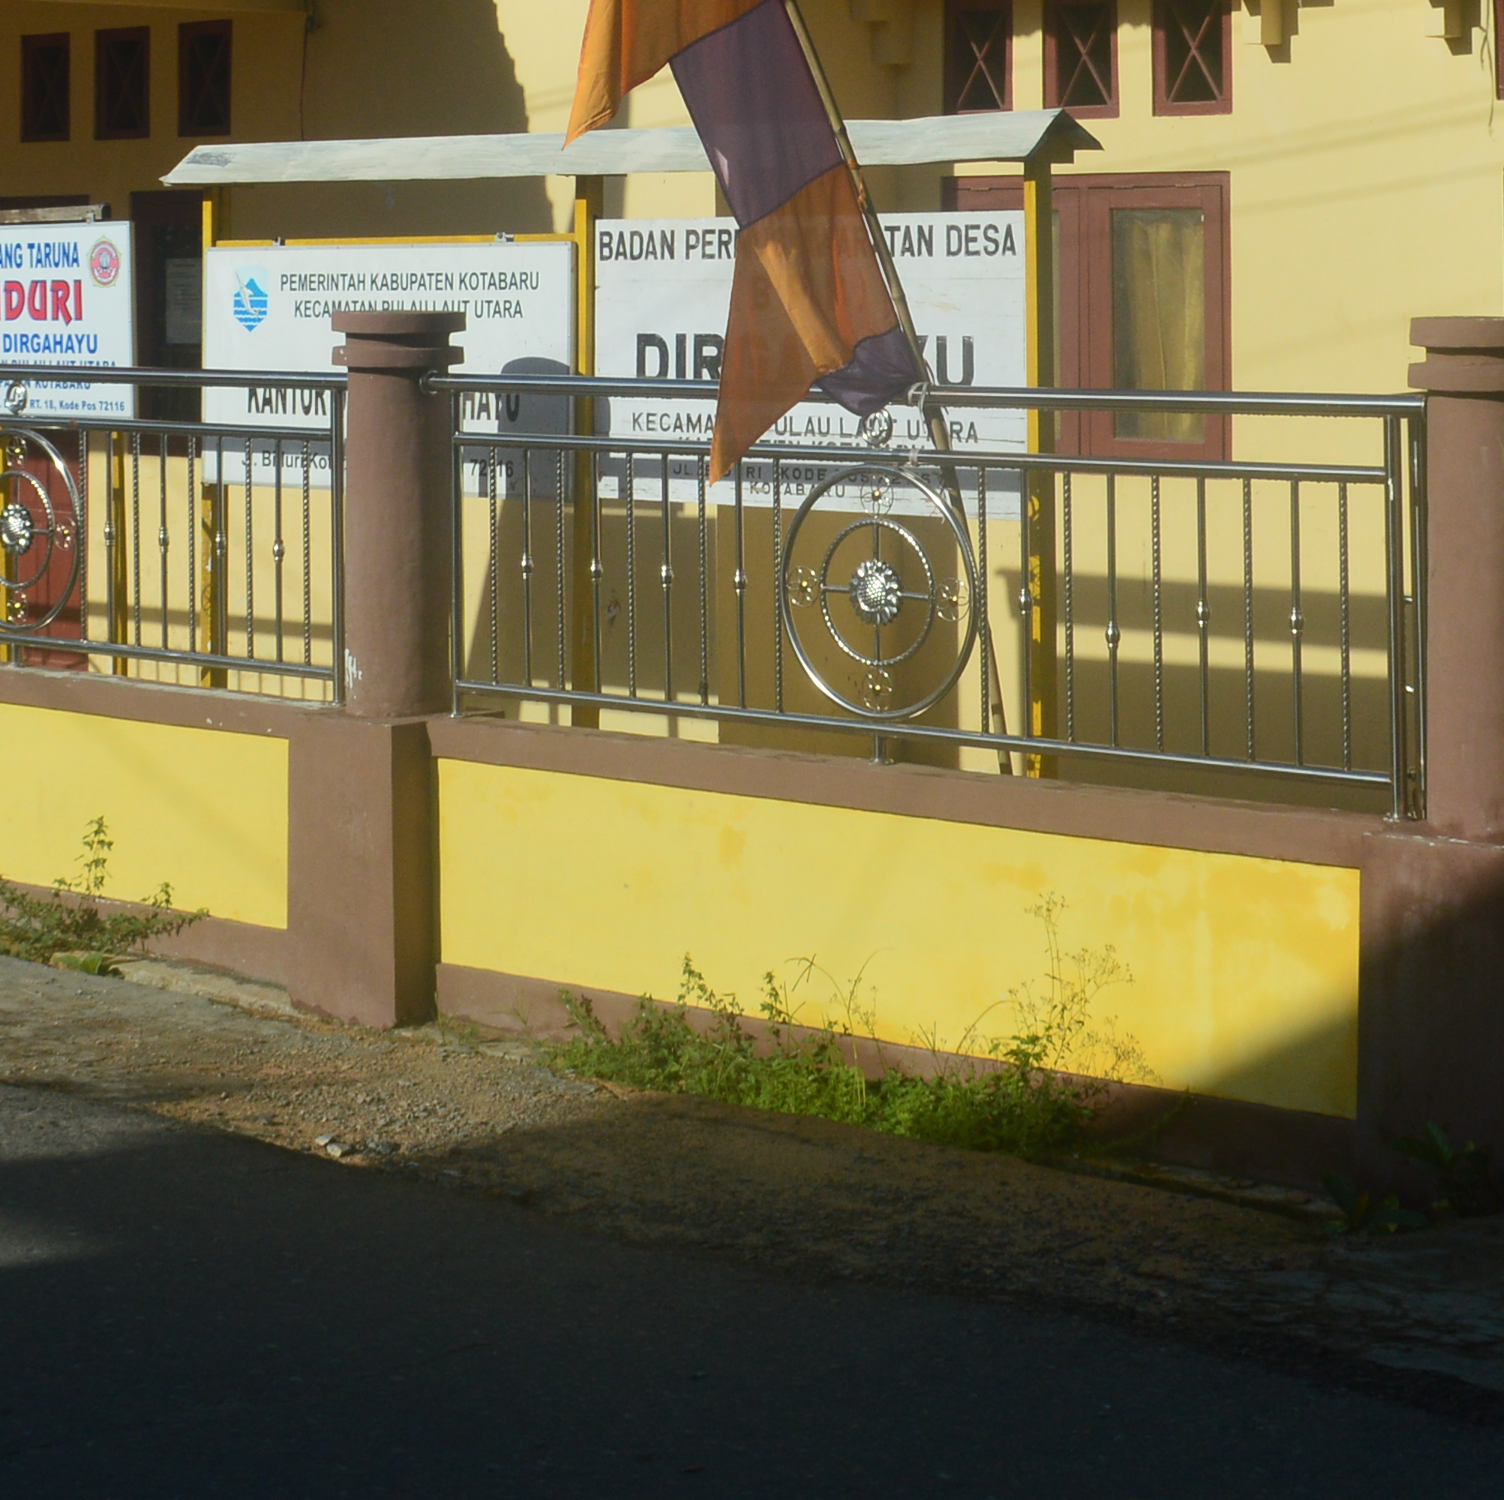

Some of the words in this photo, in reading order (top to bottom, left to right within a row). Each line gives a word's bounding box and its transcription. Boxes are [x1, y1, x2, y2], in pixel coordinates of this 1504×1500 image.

[598, 229, 676, 261] BADAN
[945, 223, 1017, 257] DESA
[27, 241, 80, 268] TARUNA
[280, 272, 366, 292] PEMERINTAH
[369, 272, 454, 292] KABUPATEN
[458, 271, 540, 291] KOTABARU
[474, 299, 524, 319] UTARA
[2, 333, 98, 354] DIRGAHAYU
[59, 400, 79, 410] Kode
[81, 401, 97, 411] Pos
[98, 401, 125, 412] 72116
[247, 387, 327, 416] KANTOR
[773, 415, 831, 438] ULAU
[469, 458, 514, 478] 7216
